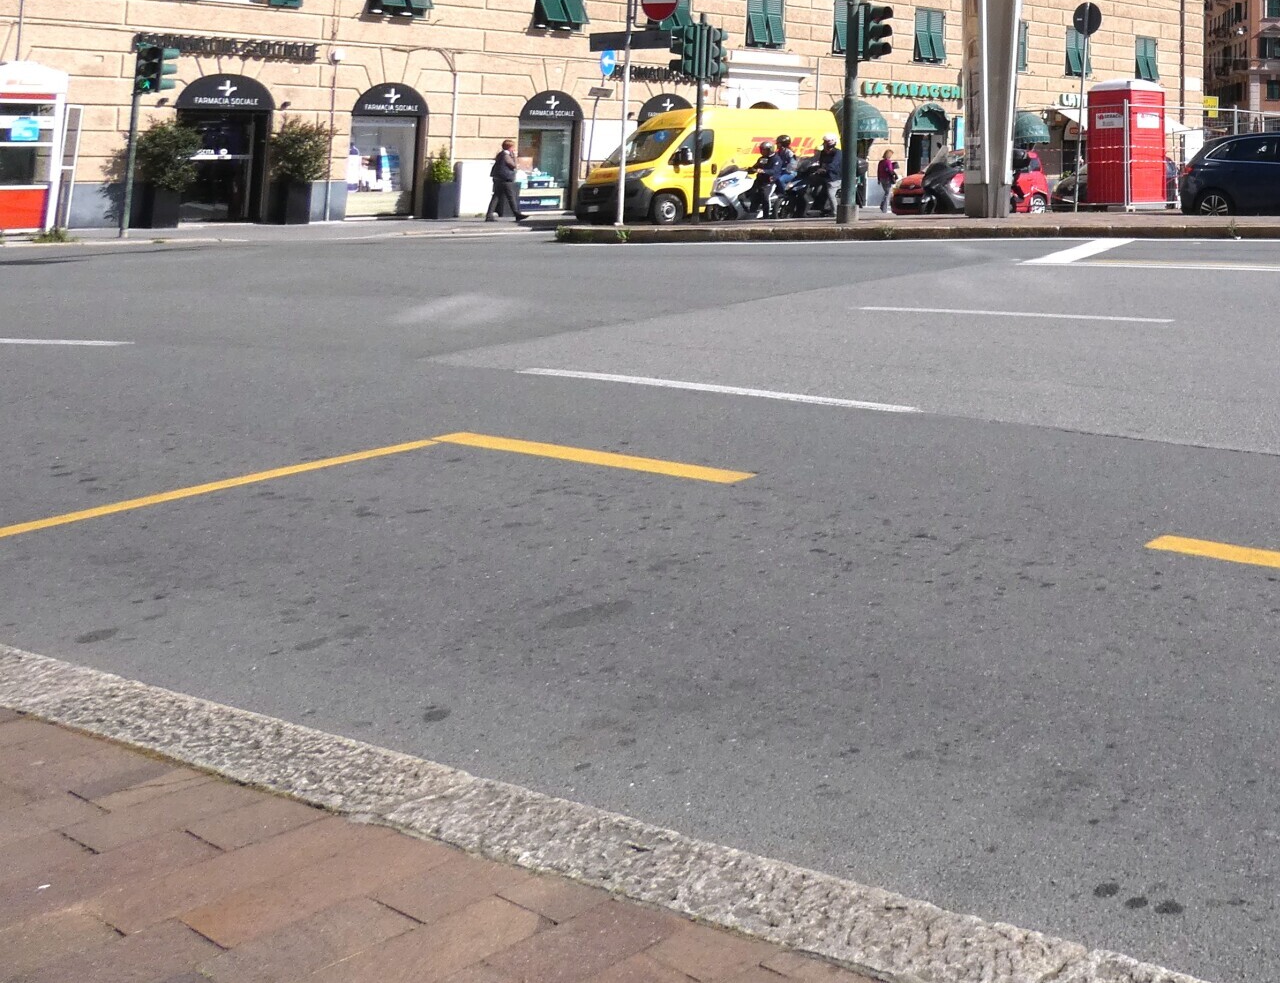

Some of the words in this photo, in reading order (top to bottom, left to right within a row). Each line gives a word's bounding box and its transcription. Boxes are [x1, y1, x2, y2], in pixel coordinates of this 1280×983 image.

[863, 80, 884, 96] LA
[891, 81, 963, 99] TABACCH
[194, 97, 230, 105] FARMACIA
[231, 98, 260, 106] SOCIALE
[364, 103, 394, 111] FARMACIA
[395, 104, 419, 112] SOCIALE
